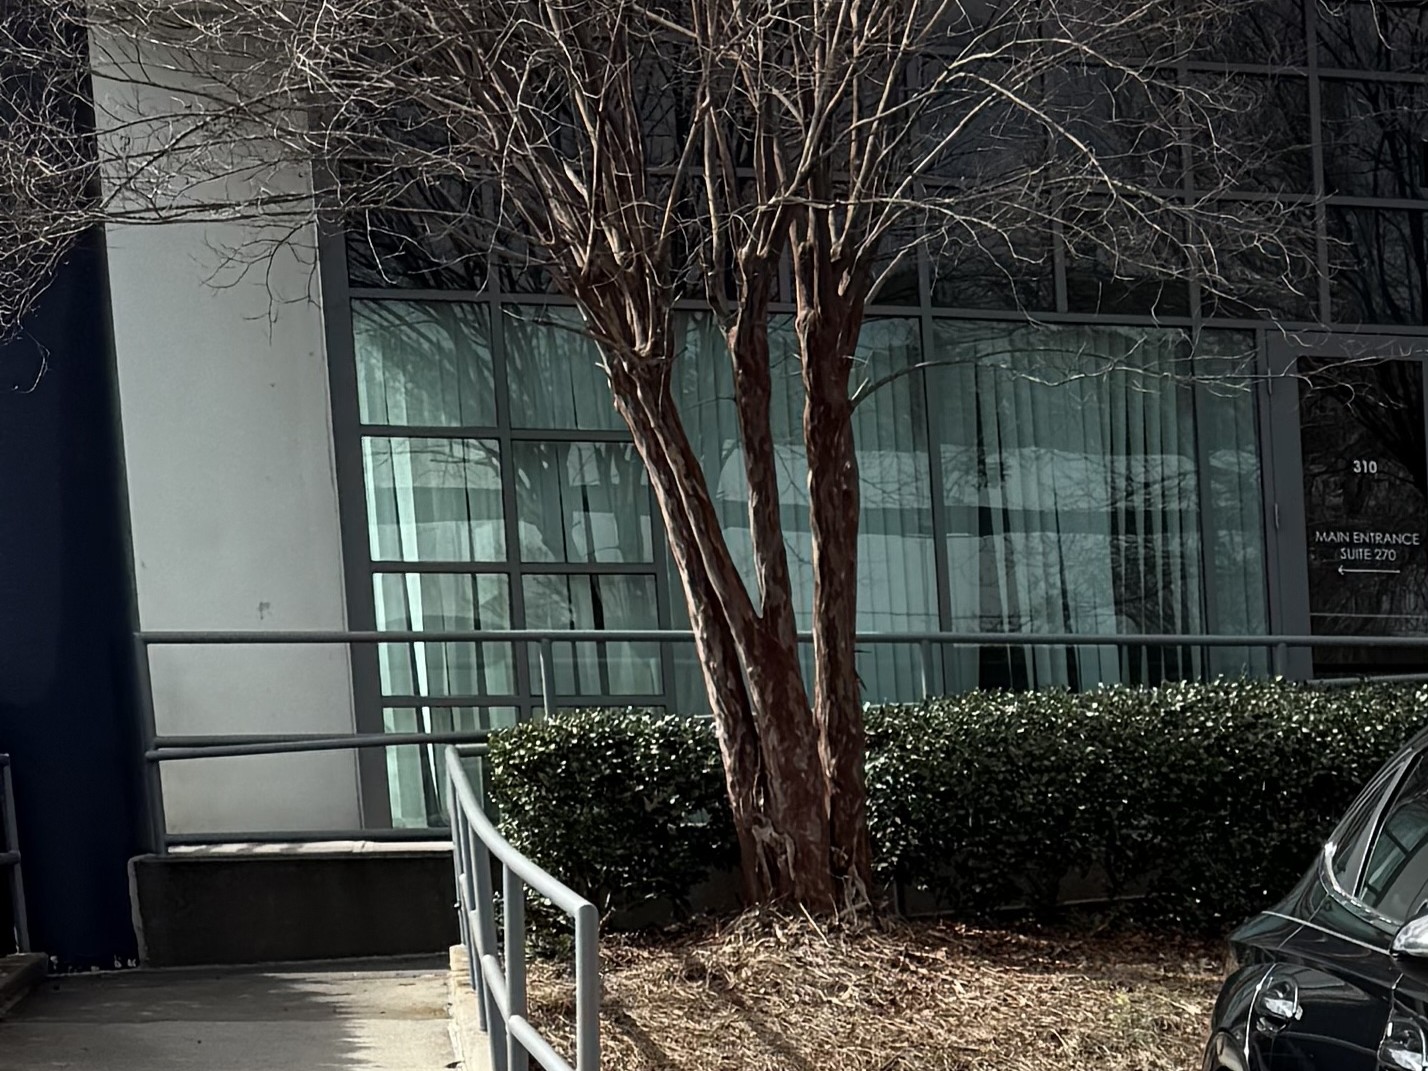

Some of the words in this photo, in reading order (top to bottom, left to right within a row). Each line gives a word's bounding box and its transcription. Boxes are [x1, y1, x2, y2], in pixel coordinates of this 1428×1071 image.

[1353, 460, 1378, 474] 310
[1315, 531, 1349, 543] MAIN
[1353, 532, 1420, 546] ENTRANCE
[1340, 548, 1371, 560] SUITE
[1375, 549, 1396, 561] 270
